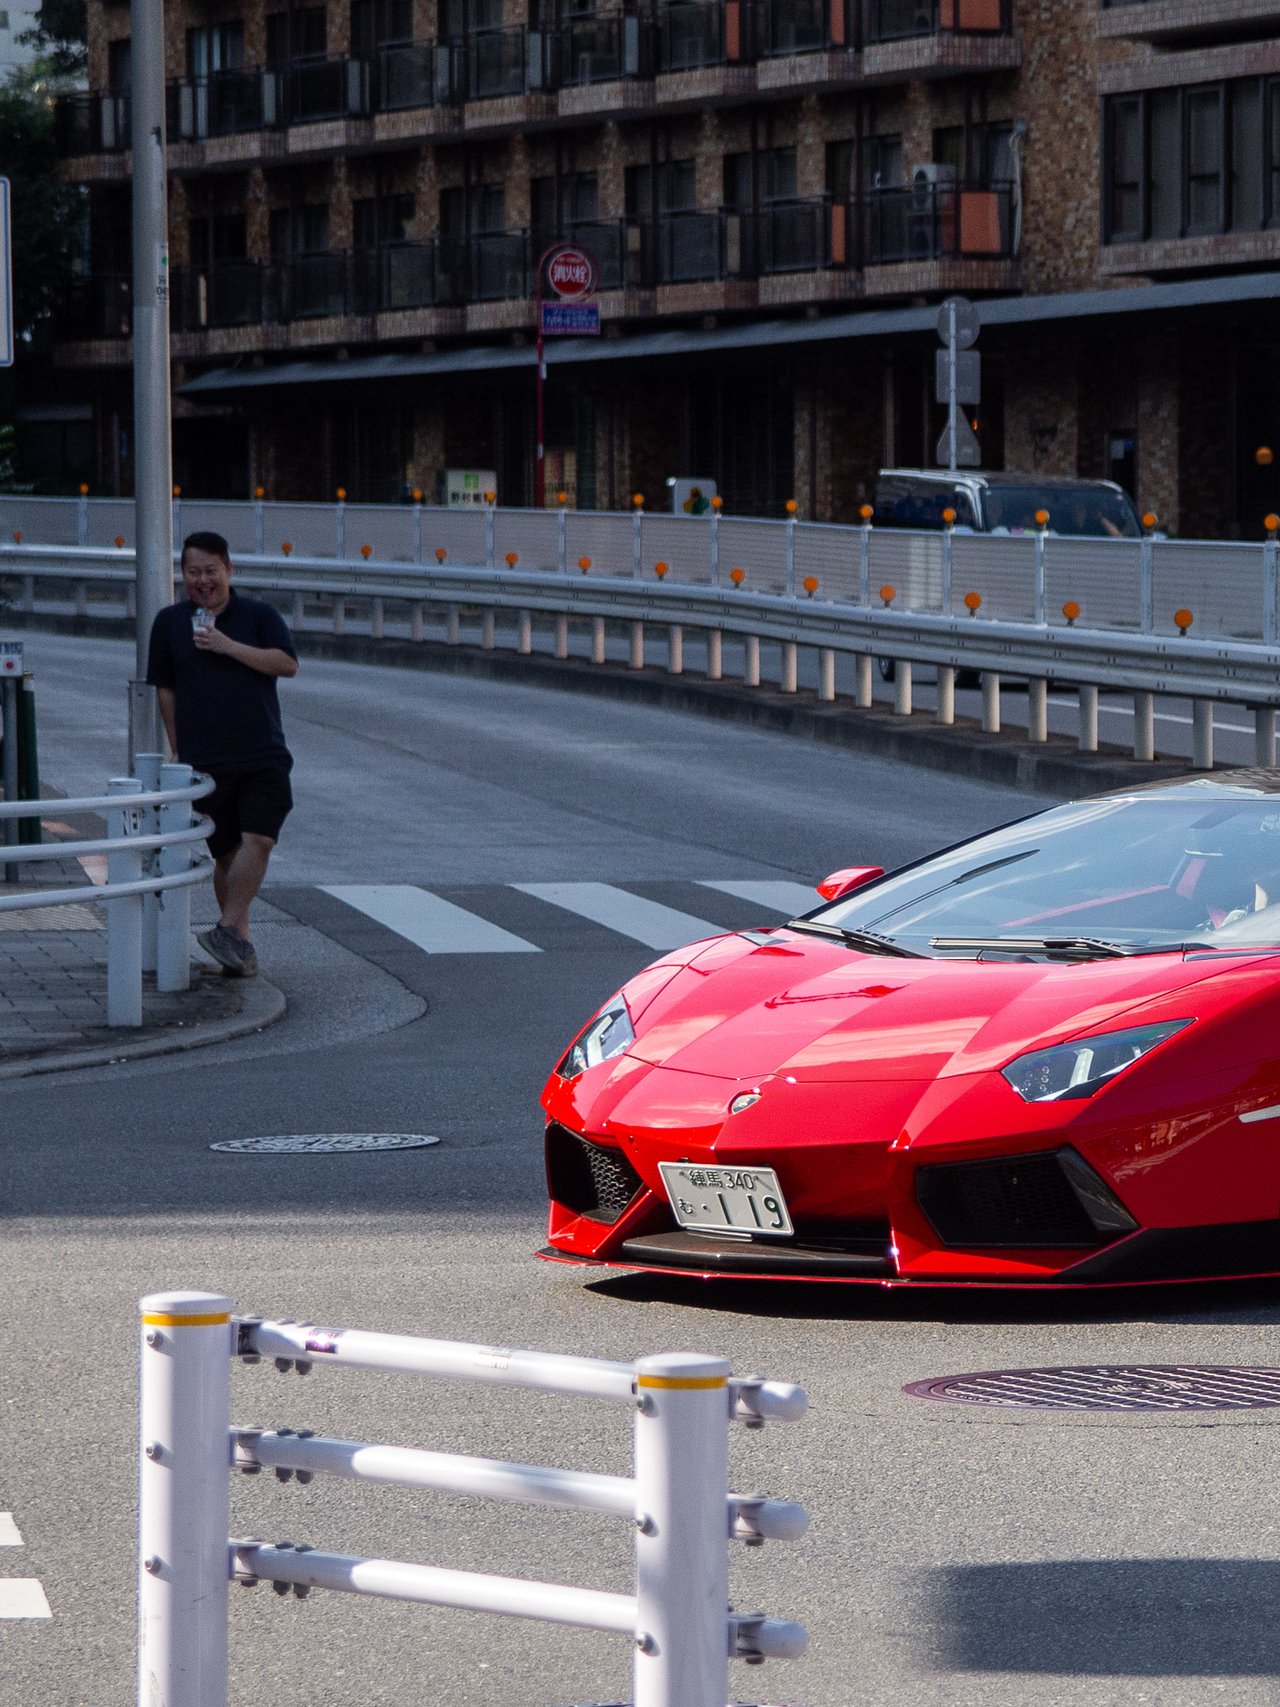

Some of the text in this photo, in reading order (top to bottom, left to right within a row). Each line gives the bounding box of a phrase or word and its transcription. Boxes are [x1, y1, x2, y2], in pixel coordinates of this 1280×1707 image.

[554, 265, 587, 283] 消火栓
[689, 1170, 754, 1190] 練馬 340
